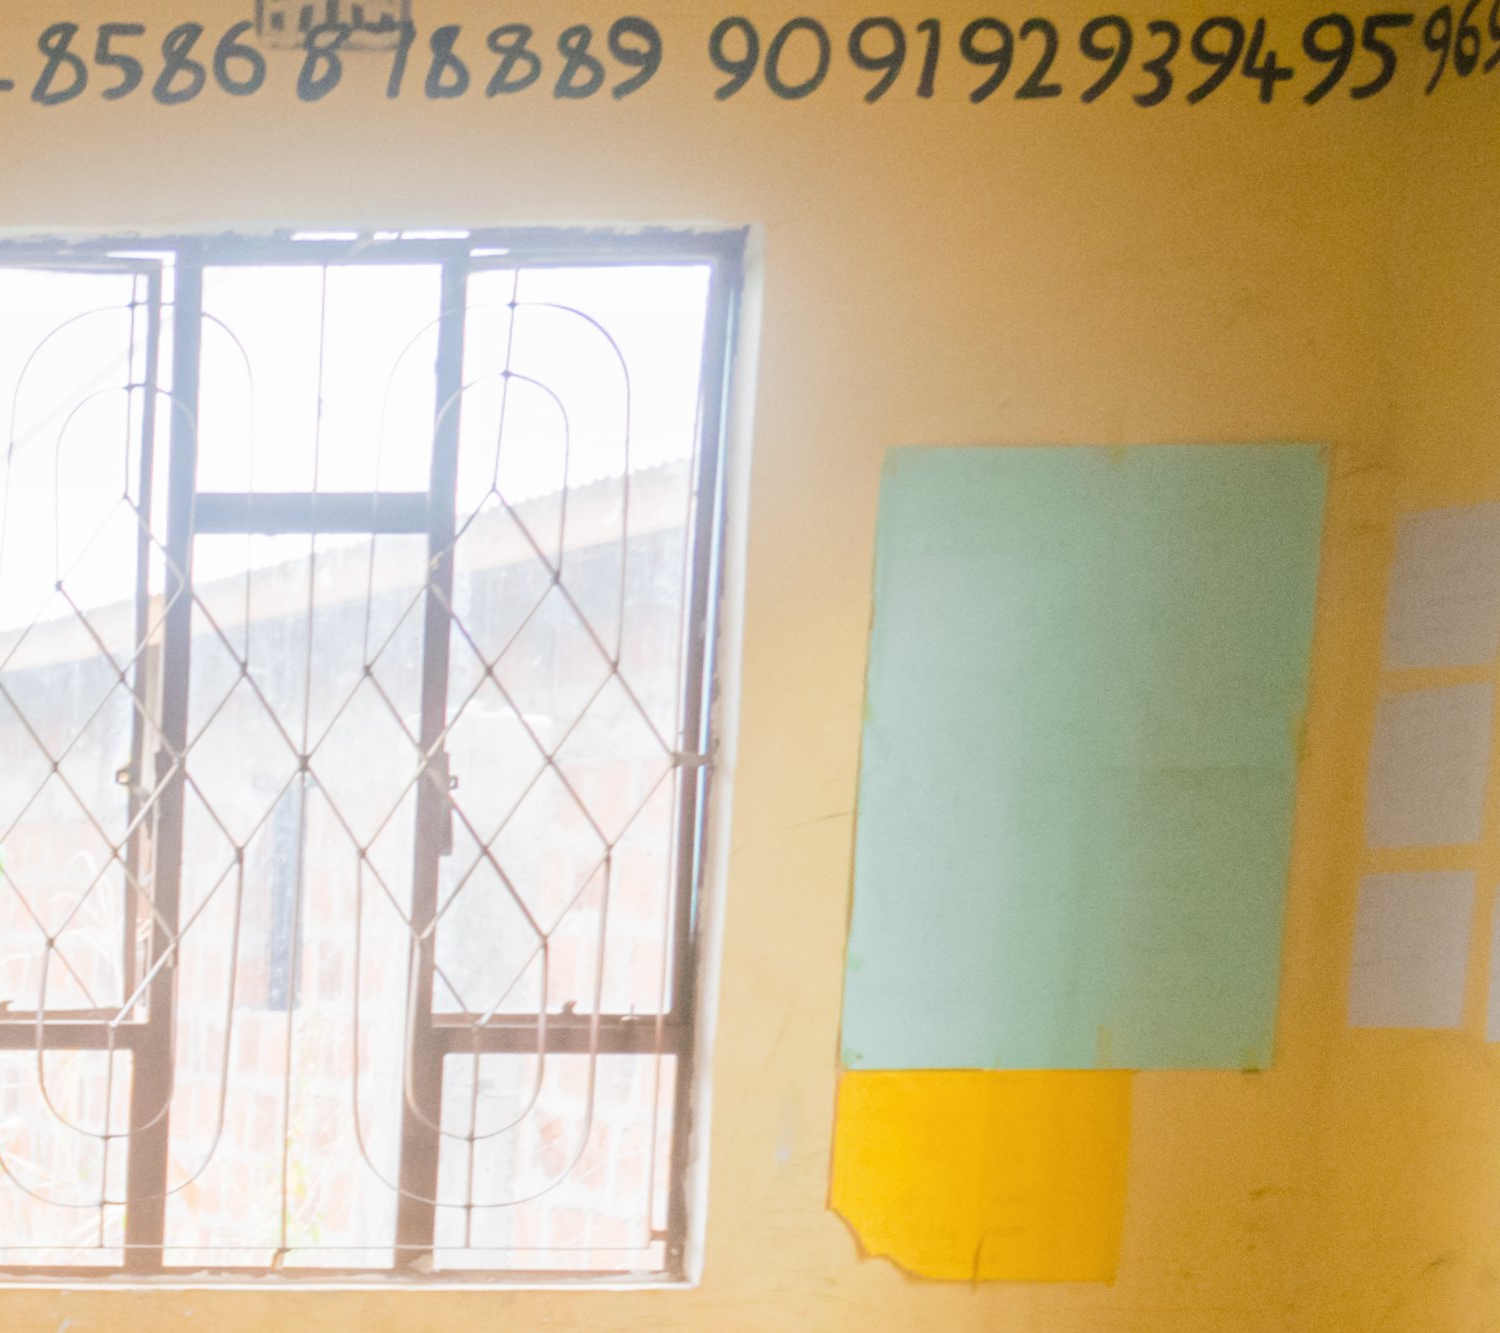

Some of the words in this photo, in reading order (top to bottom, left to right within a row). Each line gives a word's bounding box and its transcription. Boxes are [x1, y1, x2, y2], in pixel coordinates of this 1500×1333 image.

[32, 22, 145, 105] 85
[153, 20, 268, 104] 86
[426, 24, 541, 99] 88
[554, 16, 662, 99] 89
[709, 16, 830, 100] 90
[848, 17, 941, 102] 91
[959, 17, 1062, 104] 92
[1079, 14, 1182, 108] 93
[1186, 14, 1293, 106] 94
[1302, 12, 1416, 107] 95
[1423, 4, 1479, 96] 96
